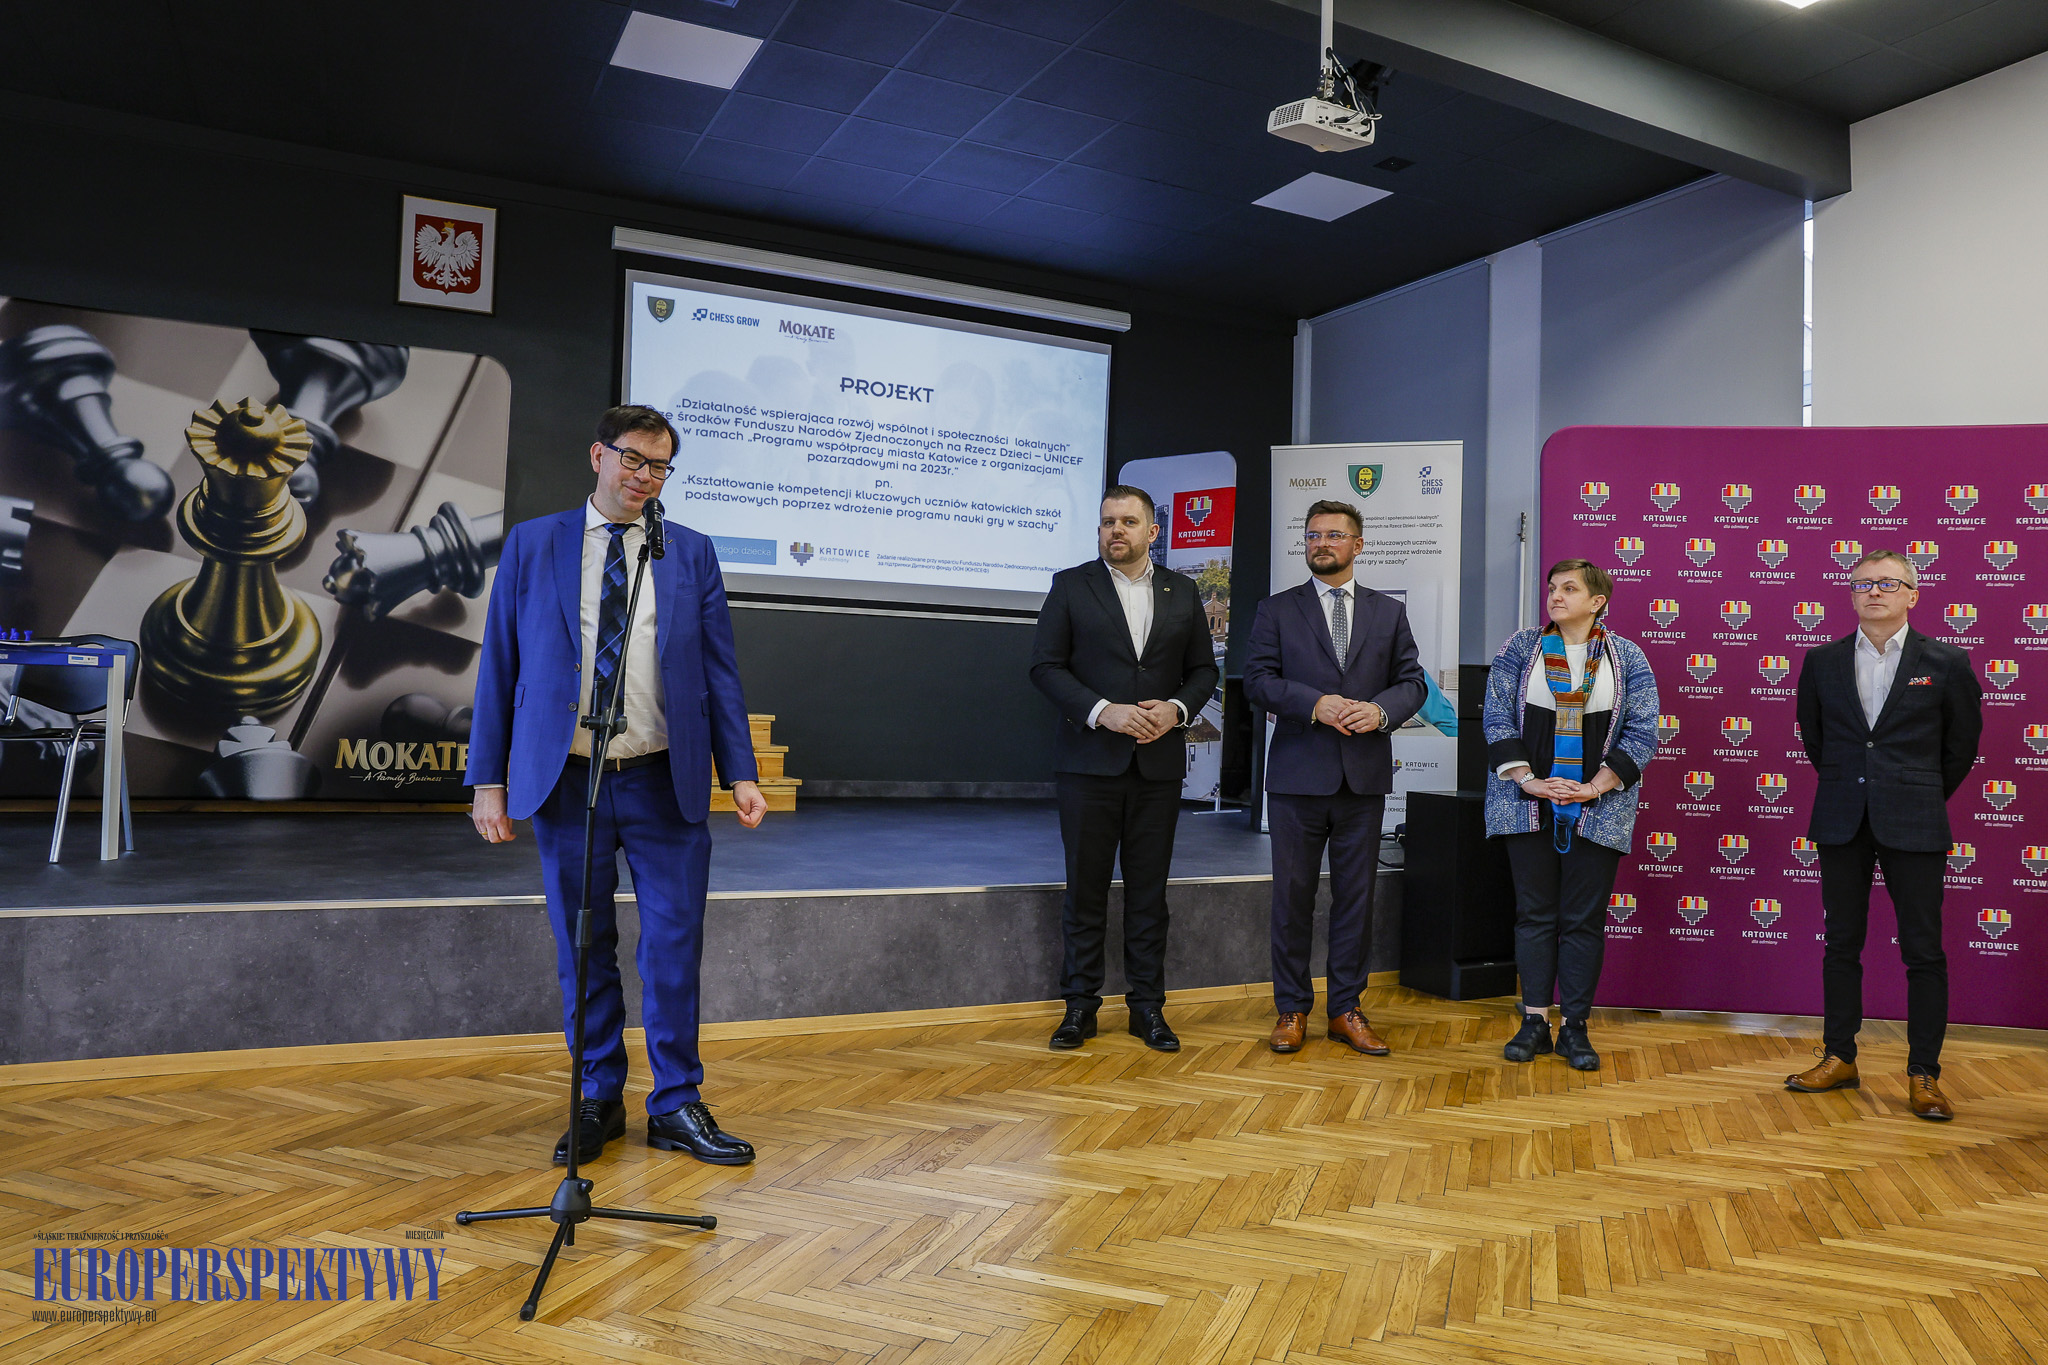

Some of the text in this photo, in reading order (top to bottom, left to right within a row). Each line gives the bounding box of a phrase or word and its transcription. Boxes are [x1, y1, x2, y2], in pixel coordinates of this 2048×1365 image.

[709, 312, 760, 328] CHESS GROW
[778, 319, 836, 340] MOKATE
[840, 376, 934, 404] PROJEKT
[676, 398, 758, 416] „Działalność
[760, 408, 834, 426] wspierająca
[838, 418, 874, 430] rozwój
[878, 422, 929, 438] wspólnot
[938, 428, 1009, 446] społeczności
[678, 411, 730, 426] środków
[734, 418, 794, 433] Funduszu
[798, 425, 852, 438] Narodów
[855, 431, 944, 450] Zjednoczonych
[947, 443, 962, 452] na
[964, 444, 997, 456] Rzecz
[1000, 448, 1032, 460] Dzieci
[1044, 453, 1083, 466] UNICEF
[682, 427, 1064, 476] w ramach „Programu współpracy miasta Katowice z organizacjami
[808, 453, 899, 470] pozarządowymi
[902, 462, 917, 472] na
[875, 478, 893, 489] pn.
[1289, 478, 1327, 487] MOKATE
[1422, 479, 1443, 487] CHESS
[1422, 487, 1442, 495] GROW
[682, 474, 1062, 518] „Kształtowanie kompetencji kluczowych uczniów katowickich szkół
[685, 490, 778, 507] podstawowych
[782, 498, 830, 510] poprzez
[834, 502, 893, 516] wdrożenie
[896, 508, 950, 522] programu
[954, 512, 984, 524] nauki
[986, 516, 1004, 528] gry
[1178, 530, 1216, 538] KATOWICE
[741, 547, 772, 556] dziecka
[819, 547, 870, 558] KATOWICE
[1823, 572, 1851, 580] KATOW
[334, 738, 470, 770] MOKATE
[363, 771, 442, 788] A Family Business
[1748, 806, 1794, 814] KATOWICE
[1975, 813, 2024, 821] KATOWICE
[1639, 864, 1683, 872] KATOWICE
[1710, 867, 1755, 875] KATOWICE
[2013, 879, 2048, 887] KATOW
[1670, 928, 1714, 936] KATOWICE
[1742, 931, 1788, 939] KATOWICE
[1969, 942, 2019, 950] KATOWICE
